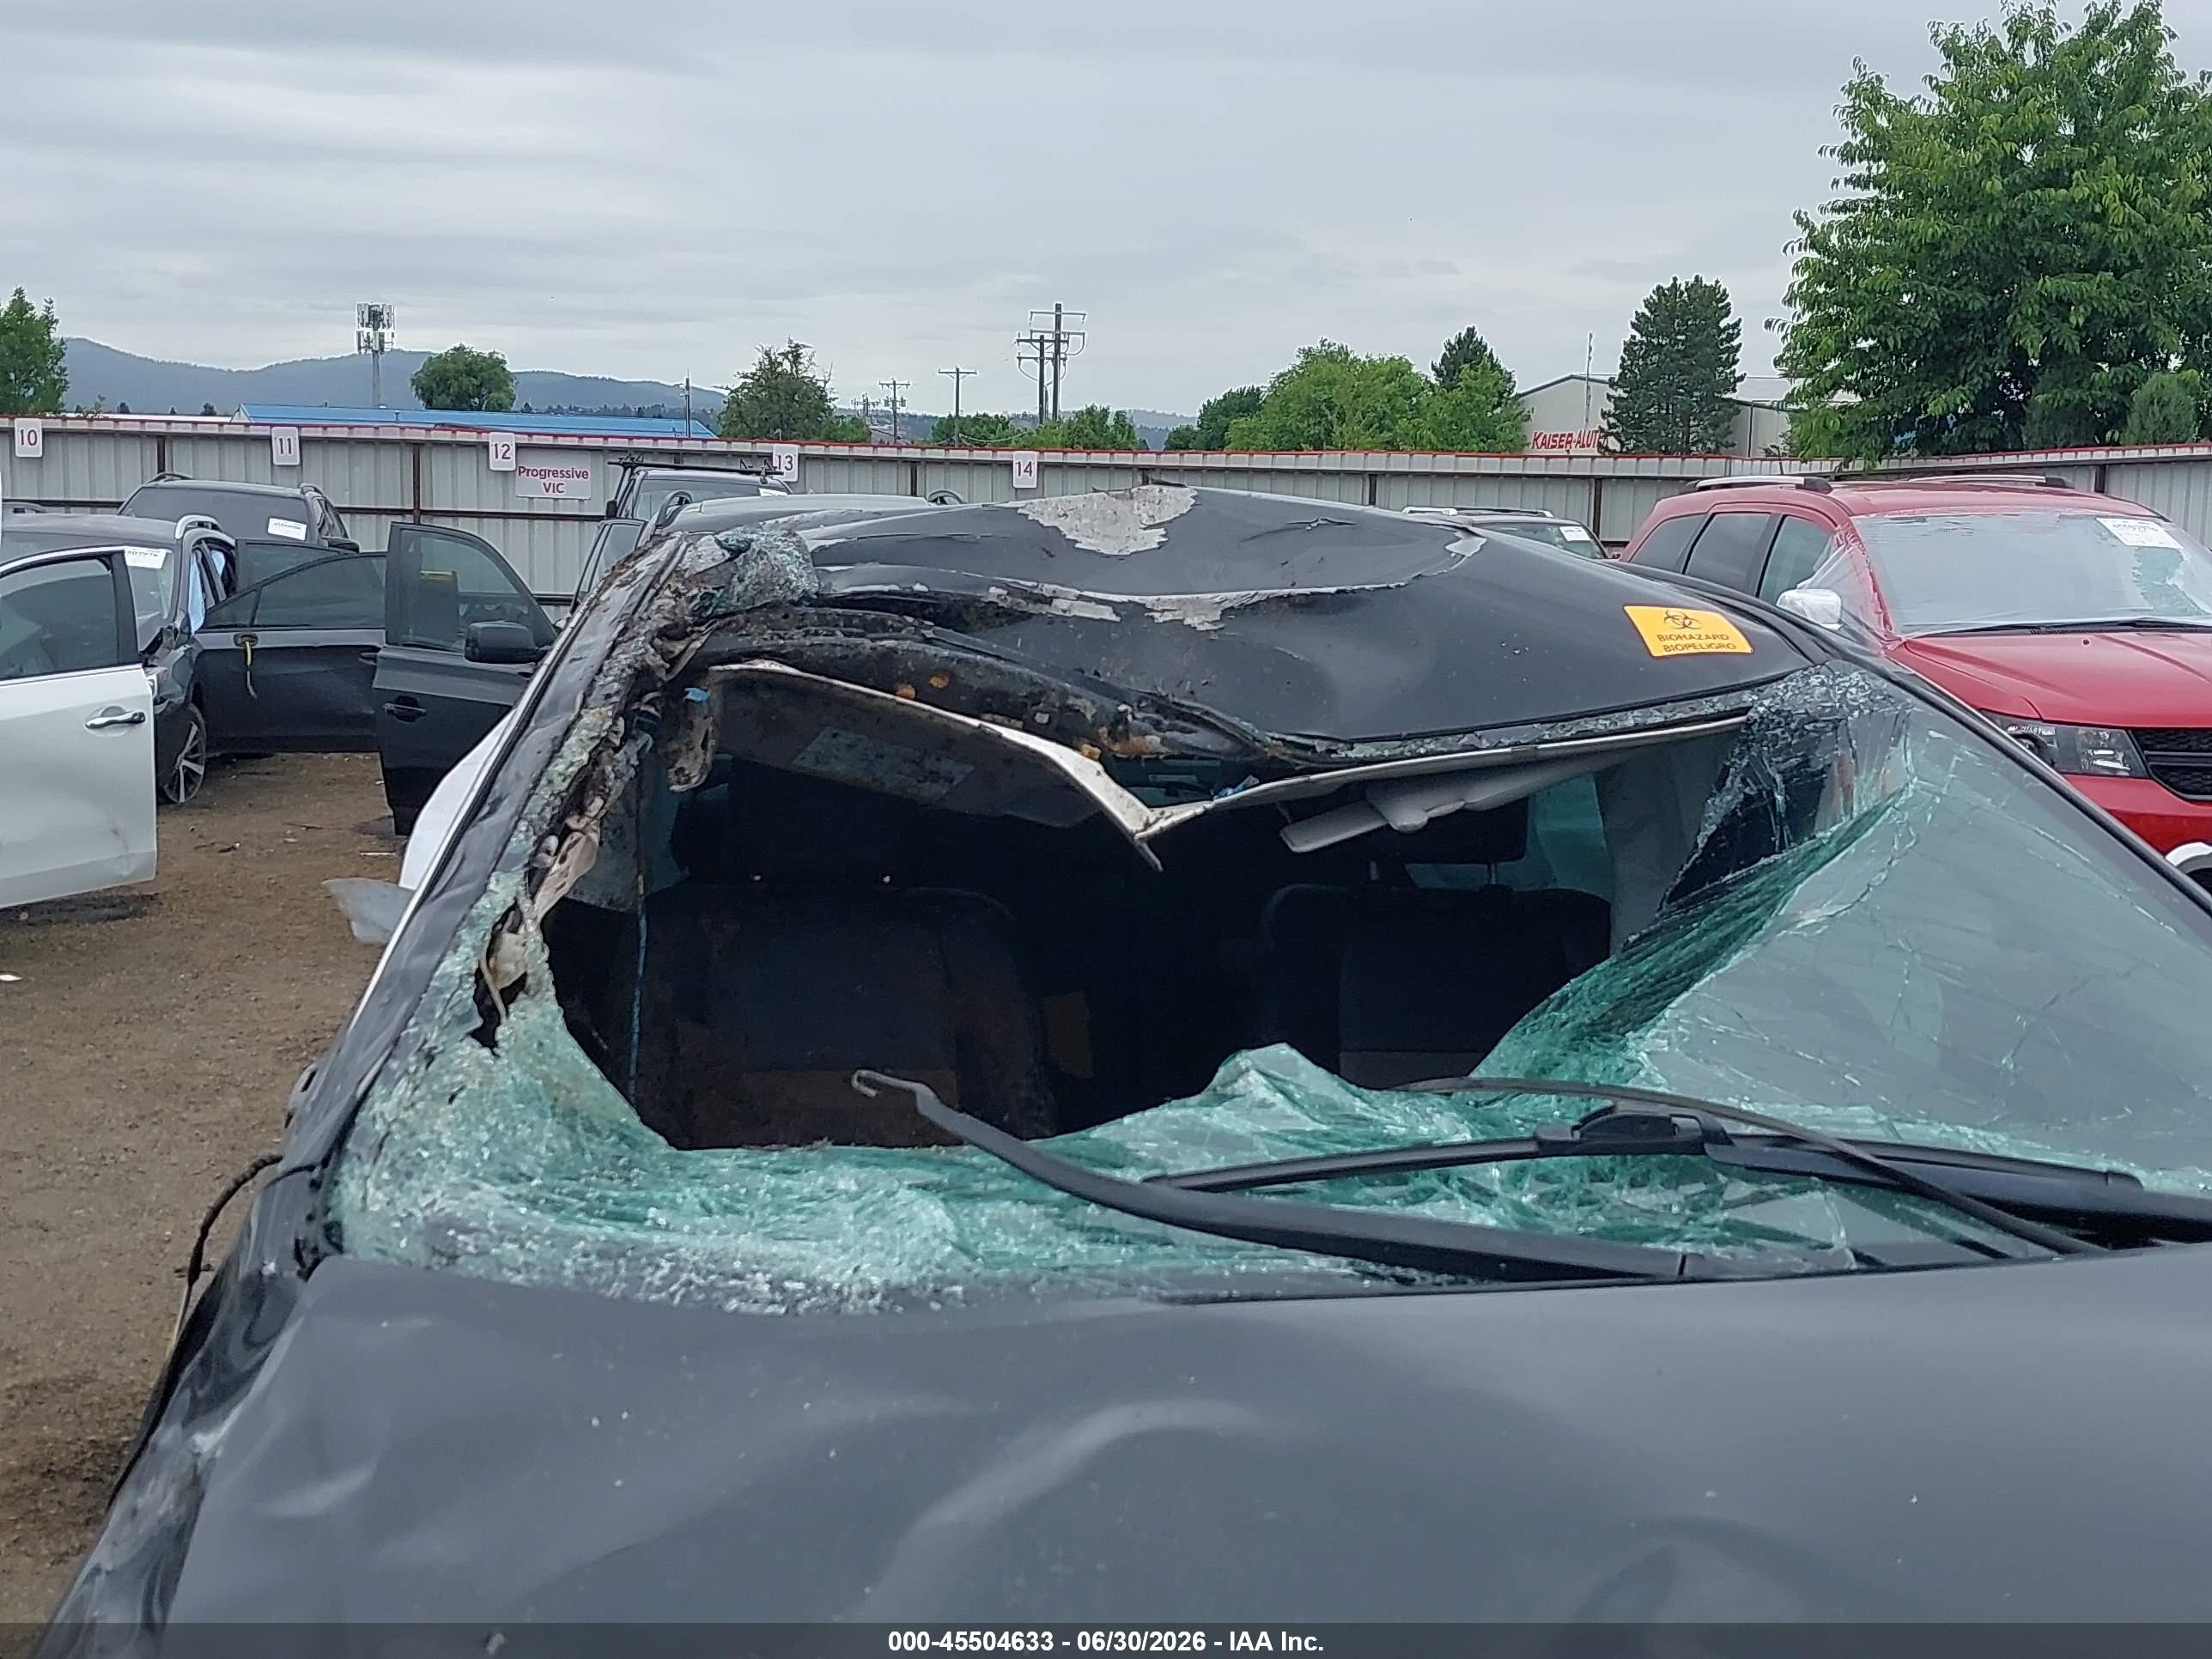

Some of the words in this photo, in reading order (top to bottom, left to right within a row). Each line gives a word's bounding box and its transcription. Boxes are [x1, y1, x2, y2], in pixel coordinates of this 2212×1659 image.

[20, 428, 38, 447] 10
[278, 437, 292, 455] 11
[494, 443, 511, 460] 12
[777, 454, 793, 471] 13
[1017, 460, 1033, 477] 14
[518, 465, 589, 480] Progressive
[543, 482, 565, 494] VIC
[1657, 633, 1729, 642] BIOHAZARD
[1662, 642, 1736, 653] BIOPELIGRO
